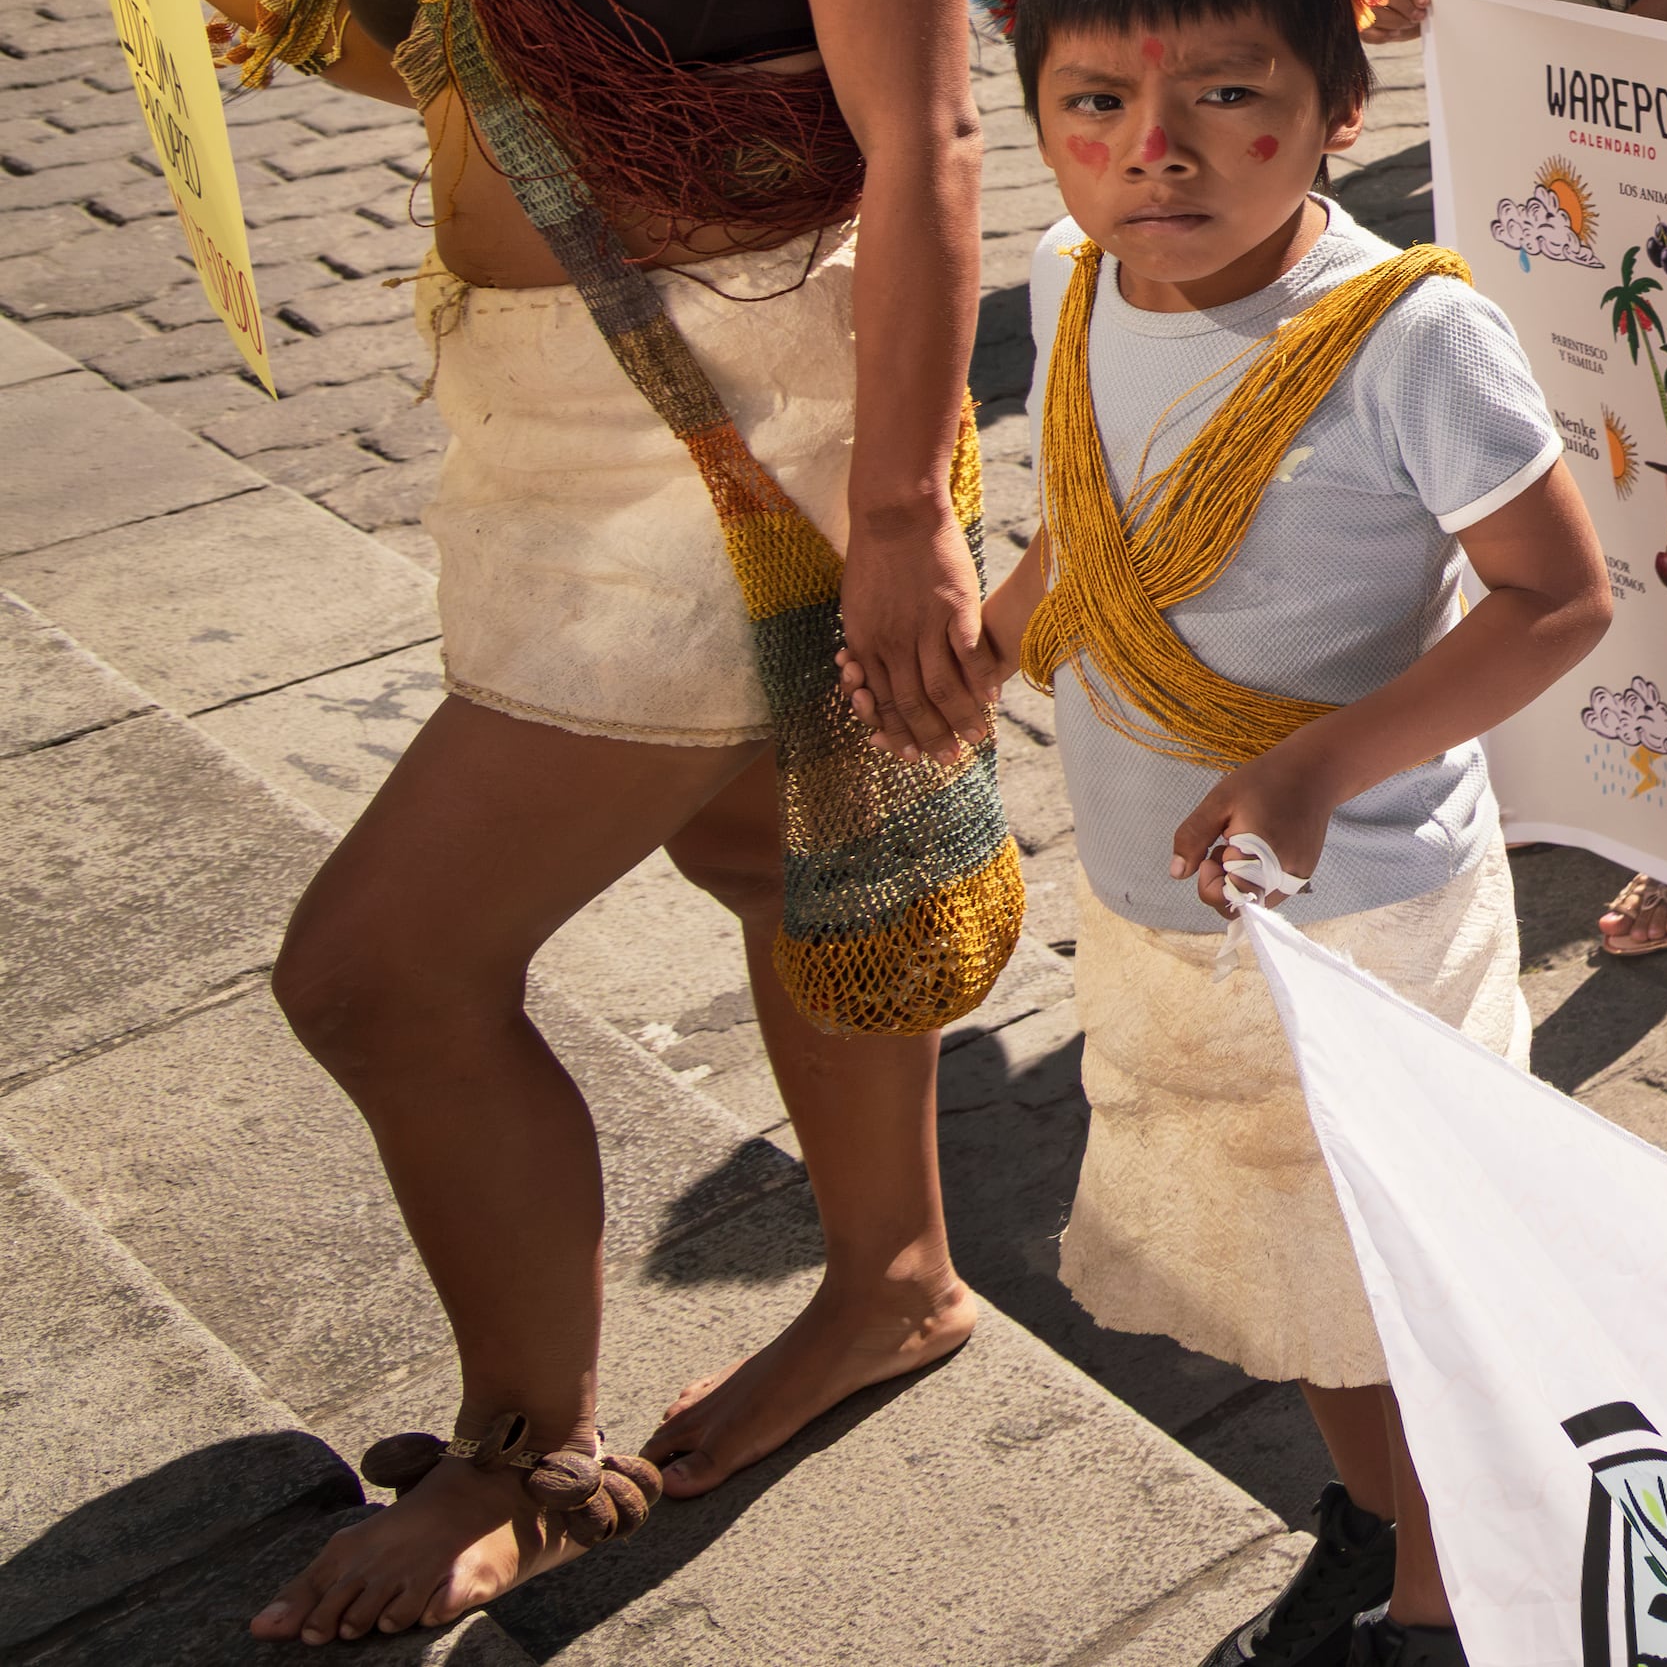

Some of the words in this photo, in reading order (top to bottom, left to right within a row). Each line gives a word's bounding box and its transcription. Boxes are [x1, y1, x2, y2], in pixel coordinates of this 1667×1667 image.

[1569, 130, 1657, 161] CALENDARIO
[1619, 182, 1638, 198] LOS
[1551, 333, 1608, 361] PARENTESCO
[1559, 349, 1567, 361] Y
[1567, 352, 1605, 375] FAMILIA
[1554, 409, 1597, 441] Nenke
